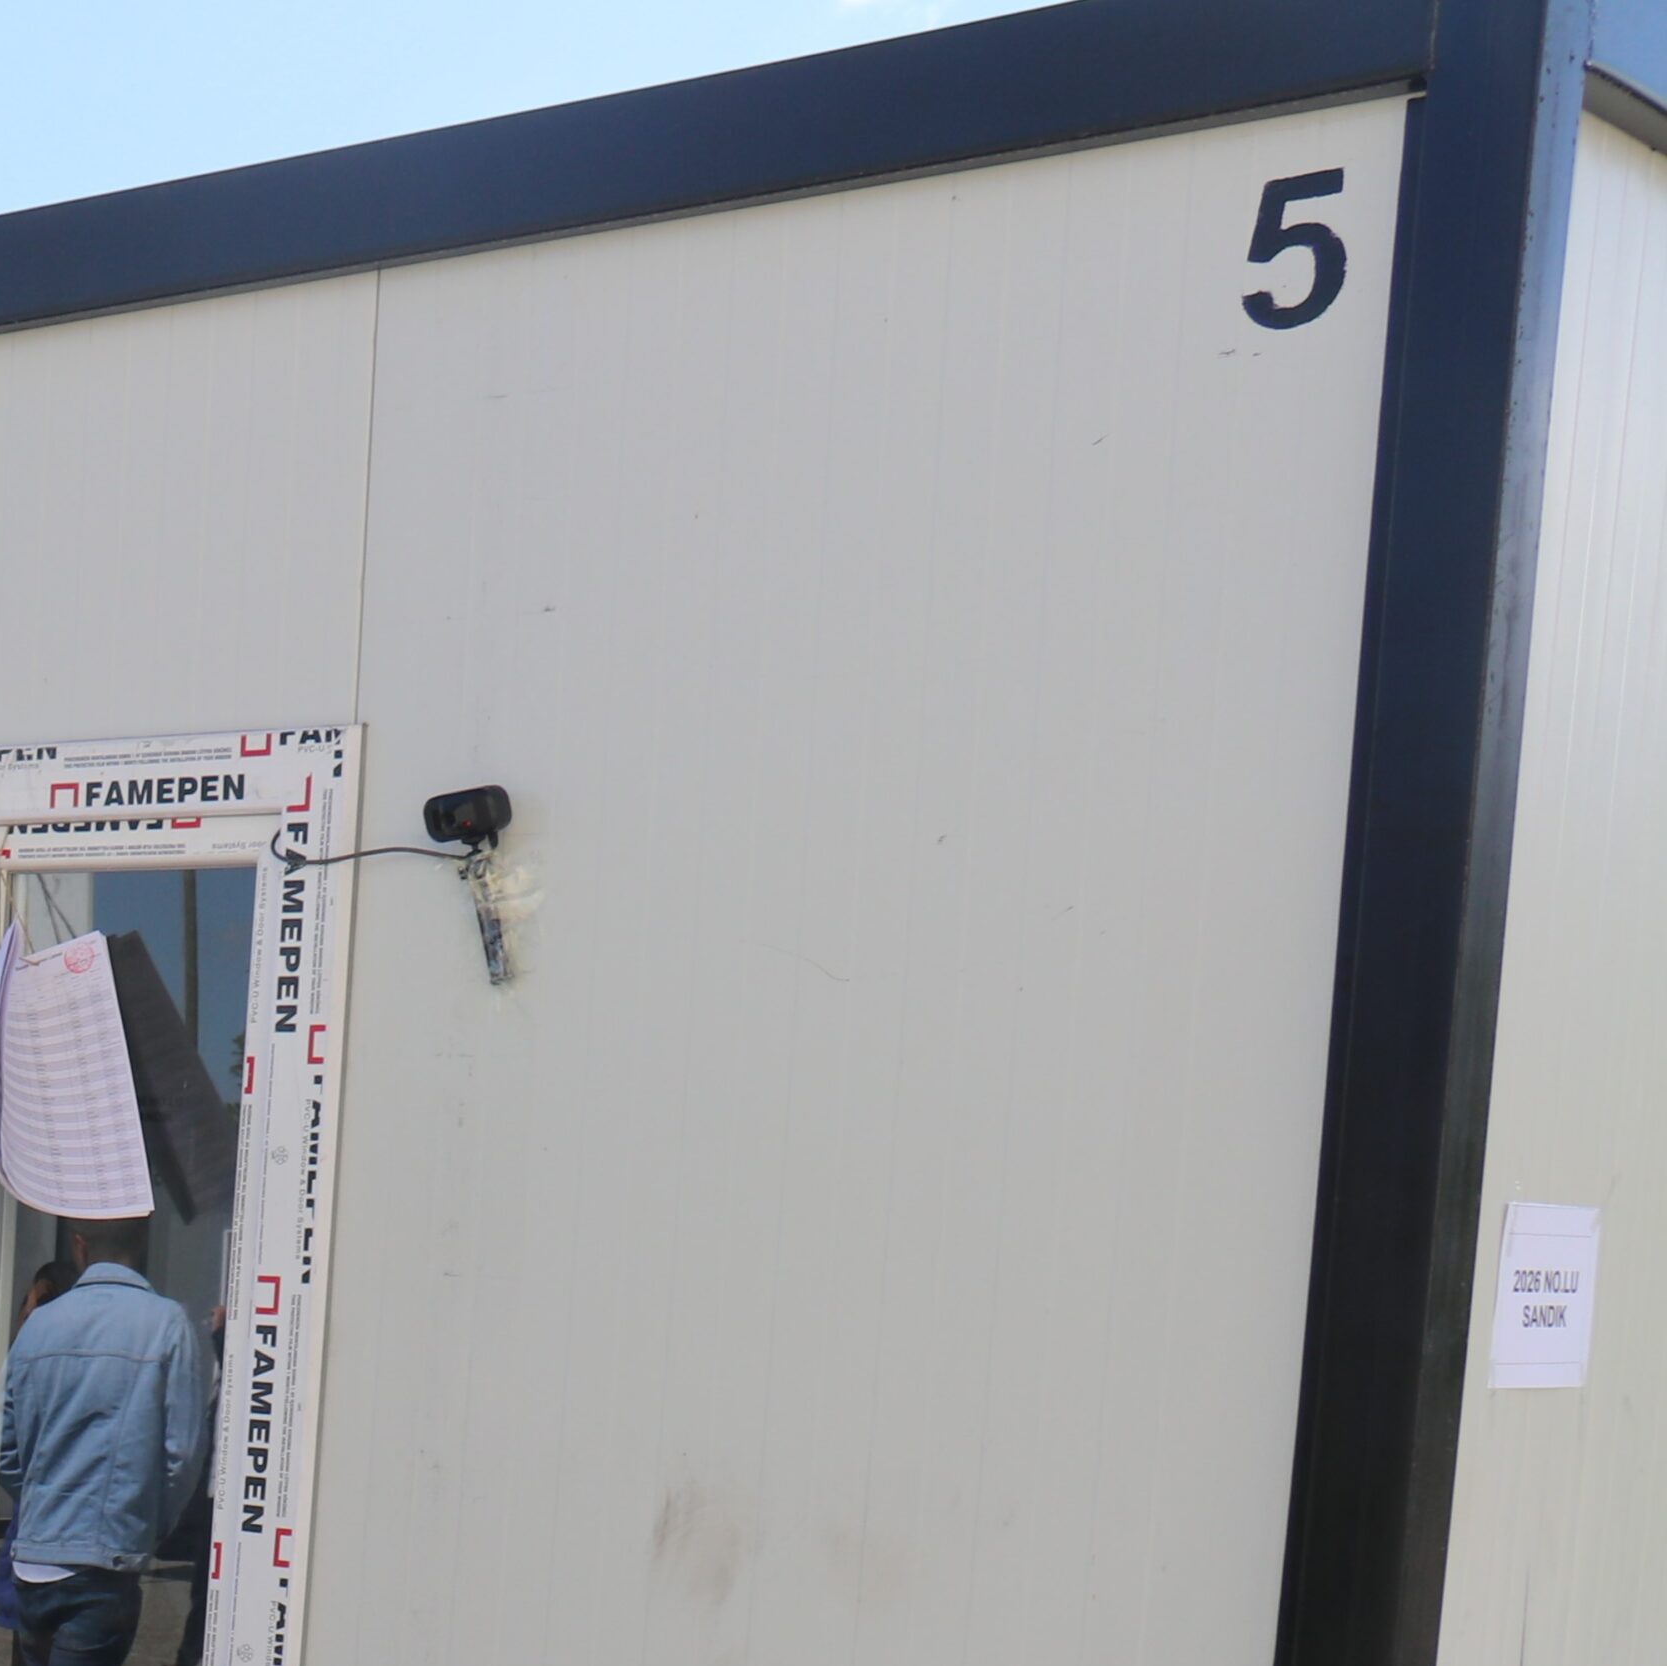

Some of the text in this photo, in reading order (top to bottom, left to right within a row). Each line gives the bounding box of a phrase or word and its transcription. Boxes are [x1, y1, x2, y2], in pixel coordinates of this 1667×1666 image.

[1242, 167, 1347, 330] 5
[85, 774, 245, 807] FAMEPEN
[259, 867, 268, 909] Systems
[257, 911, 265, 936] Door
[275, 822, 308, 1033] FAMEPEN
[253, 948, 262, 989] Window
[251, 990, 260, 1024] PVC-U
[303, 1098, 311, 1133] PVC-U
[300, 1135, 309, 1176] Window
[295, 1216, 303, 1260] Systems
[1513, 1270, 1541, 1293] 2026
[1522, 1305, 1567, 1328] SANDIK
[226, 1353, 234, 1396] Systems
[242, 1325, 277, 1533] FAMEPEN
[220, 1435, 229, 1475] Window
[218, 1477, 226, 1510] PVC-U
[267, 1600, 276, 1634] PVC-U
